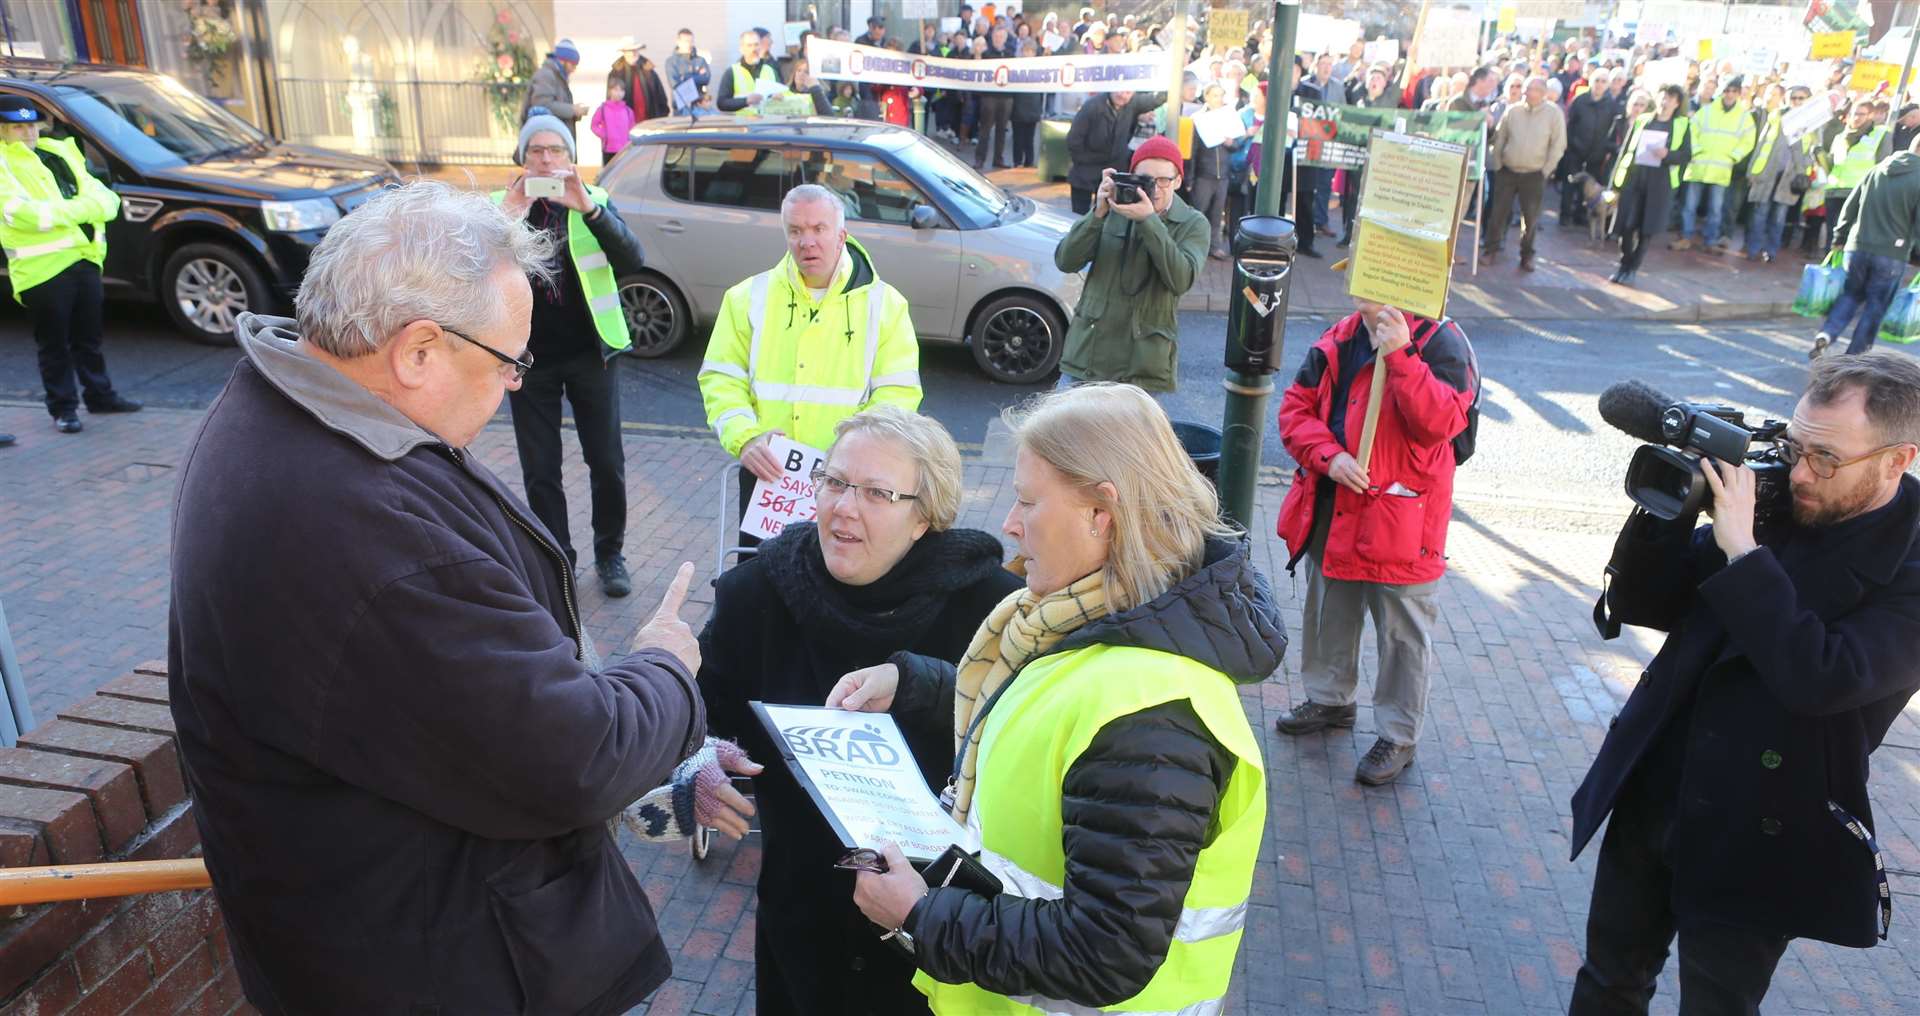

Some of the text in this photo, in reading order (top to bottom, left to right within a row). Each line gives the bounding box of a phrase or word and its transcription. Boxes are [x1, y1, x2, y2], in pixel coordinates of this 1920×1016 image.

[1302, 102, 1340, 121] SAY
[782, 733, 900, 766] BRAD
[820, 768, 897, 790] PETITION
